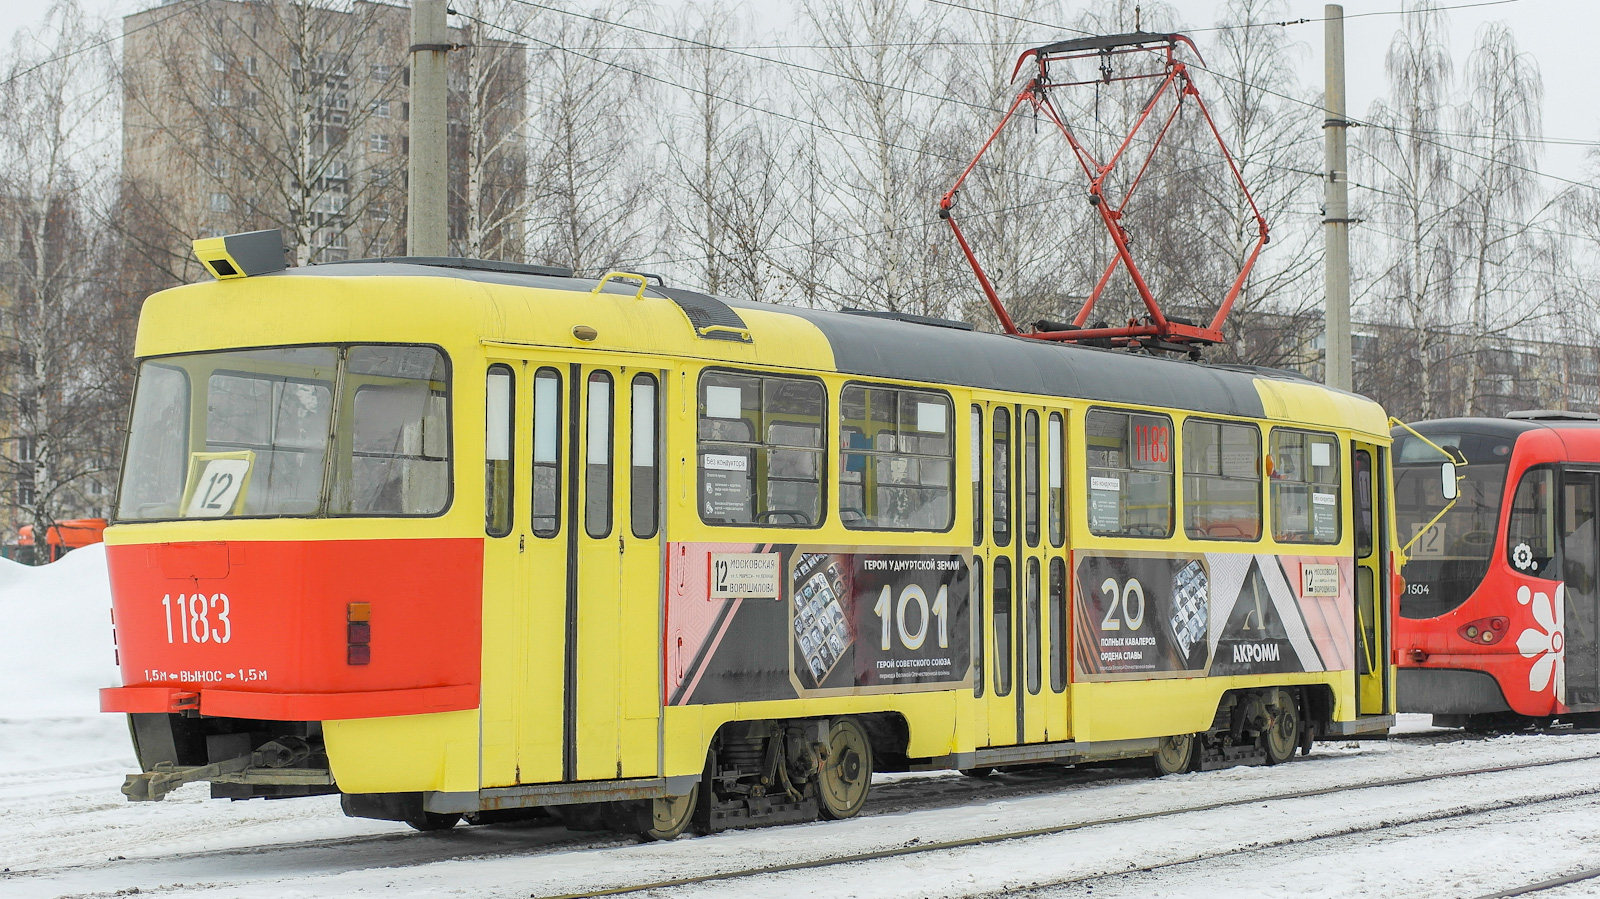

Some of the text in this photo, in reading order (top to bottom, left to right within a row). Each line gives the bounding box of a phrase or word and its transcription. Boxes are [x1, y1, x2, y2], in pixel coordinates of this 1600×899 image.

[1135, 425, 1168, 462] 1183
[706, 457, 745, 468] Без кондуктора
[201, 473, 233, 508] 12
[1418, 526, 1439, 552] 12
[730, 559, 775, 569] МОСКОВСКАЯ
[864, 558, 960, 571] ГЕРОИ УДМУРТСКОЙ ЗЕМЛИ
[716, 560, 728, 592] 12
[1305, 569, 1313, 592] 12
[730, 583, 774, 592] ВОРОШИЛОВА
[1407, 584, 1430, 594] 1504
[1101, 578, 1145, 630] 20
[162, 593, 231, 644] 1183
[874, 584, 948, 650] 101
[1100, 637, 1156, 647] ПОЛНЫХ КАВАЛЕРОВ
[1100, 652, 1142, 661] ОРДЕНА СЛАВЫ
[1233, 643, 1280, 663] АКРОМИ
[876, 658, 951, 669] ГЕРОЙ СОВЕТСКОГО СОЮЗА
[180, 670, 222, 682] ВЫНОС
